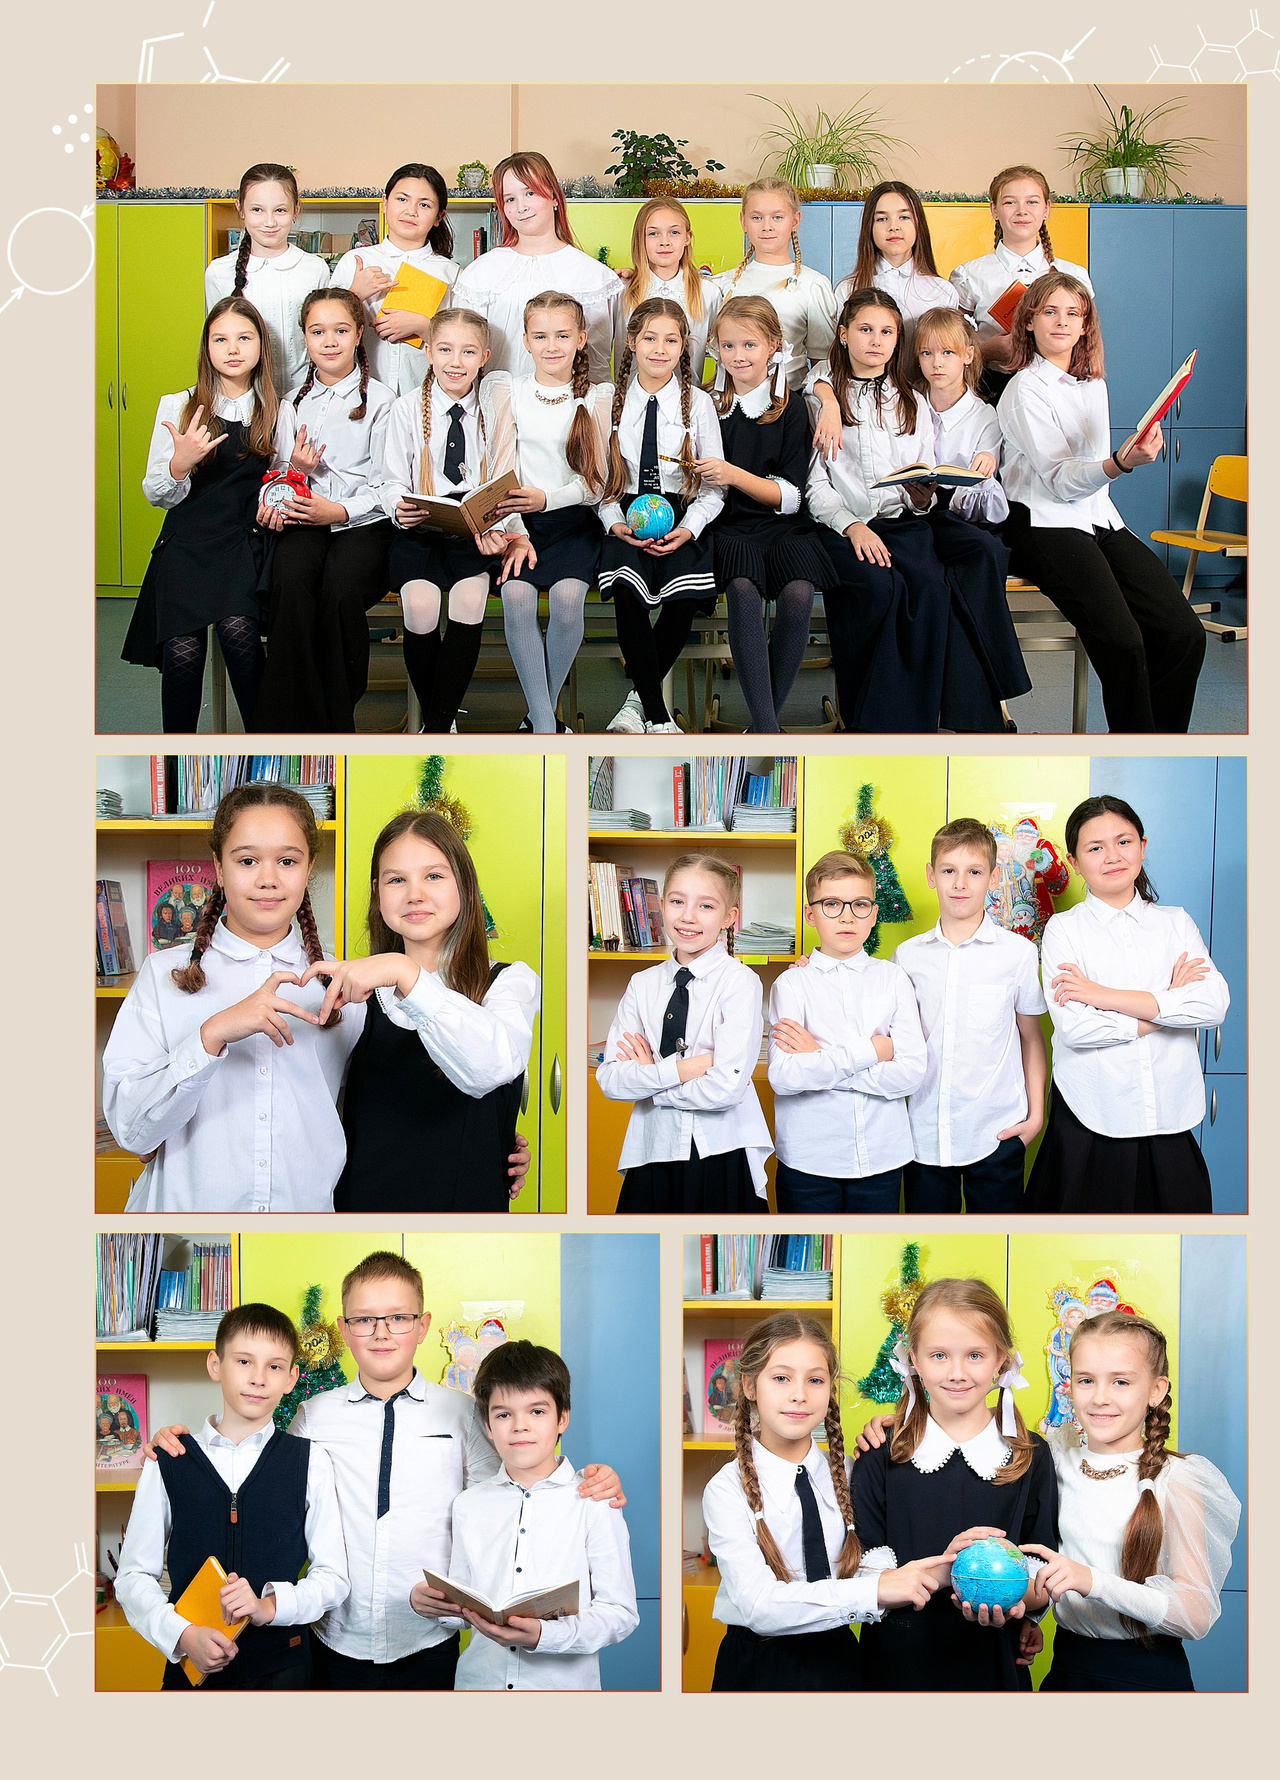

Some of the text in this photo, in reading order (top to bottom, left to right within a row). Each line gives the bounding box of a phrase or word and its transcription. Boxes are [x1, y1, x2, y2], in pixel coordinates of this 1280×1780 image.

[156, 755, 164, 782] ШКОЛЬНИ
[175, 865, 202, 874] 100
[153, 874, 194, 897] ВЕЛИКИХ
[98, 1378, 117, 1386] 00
[115, 1388, 137, 1404] ИМЁН
[96, 1459, 131, 1468] ИТЕРАТУРЕ
